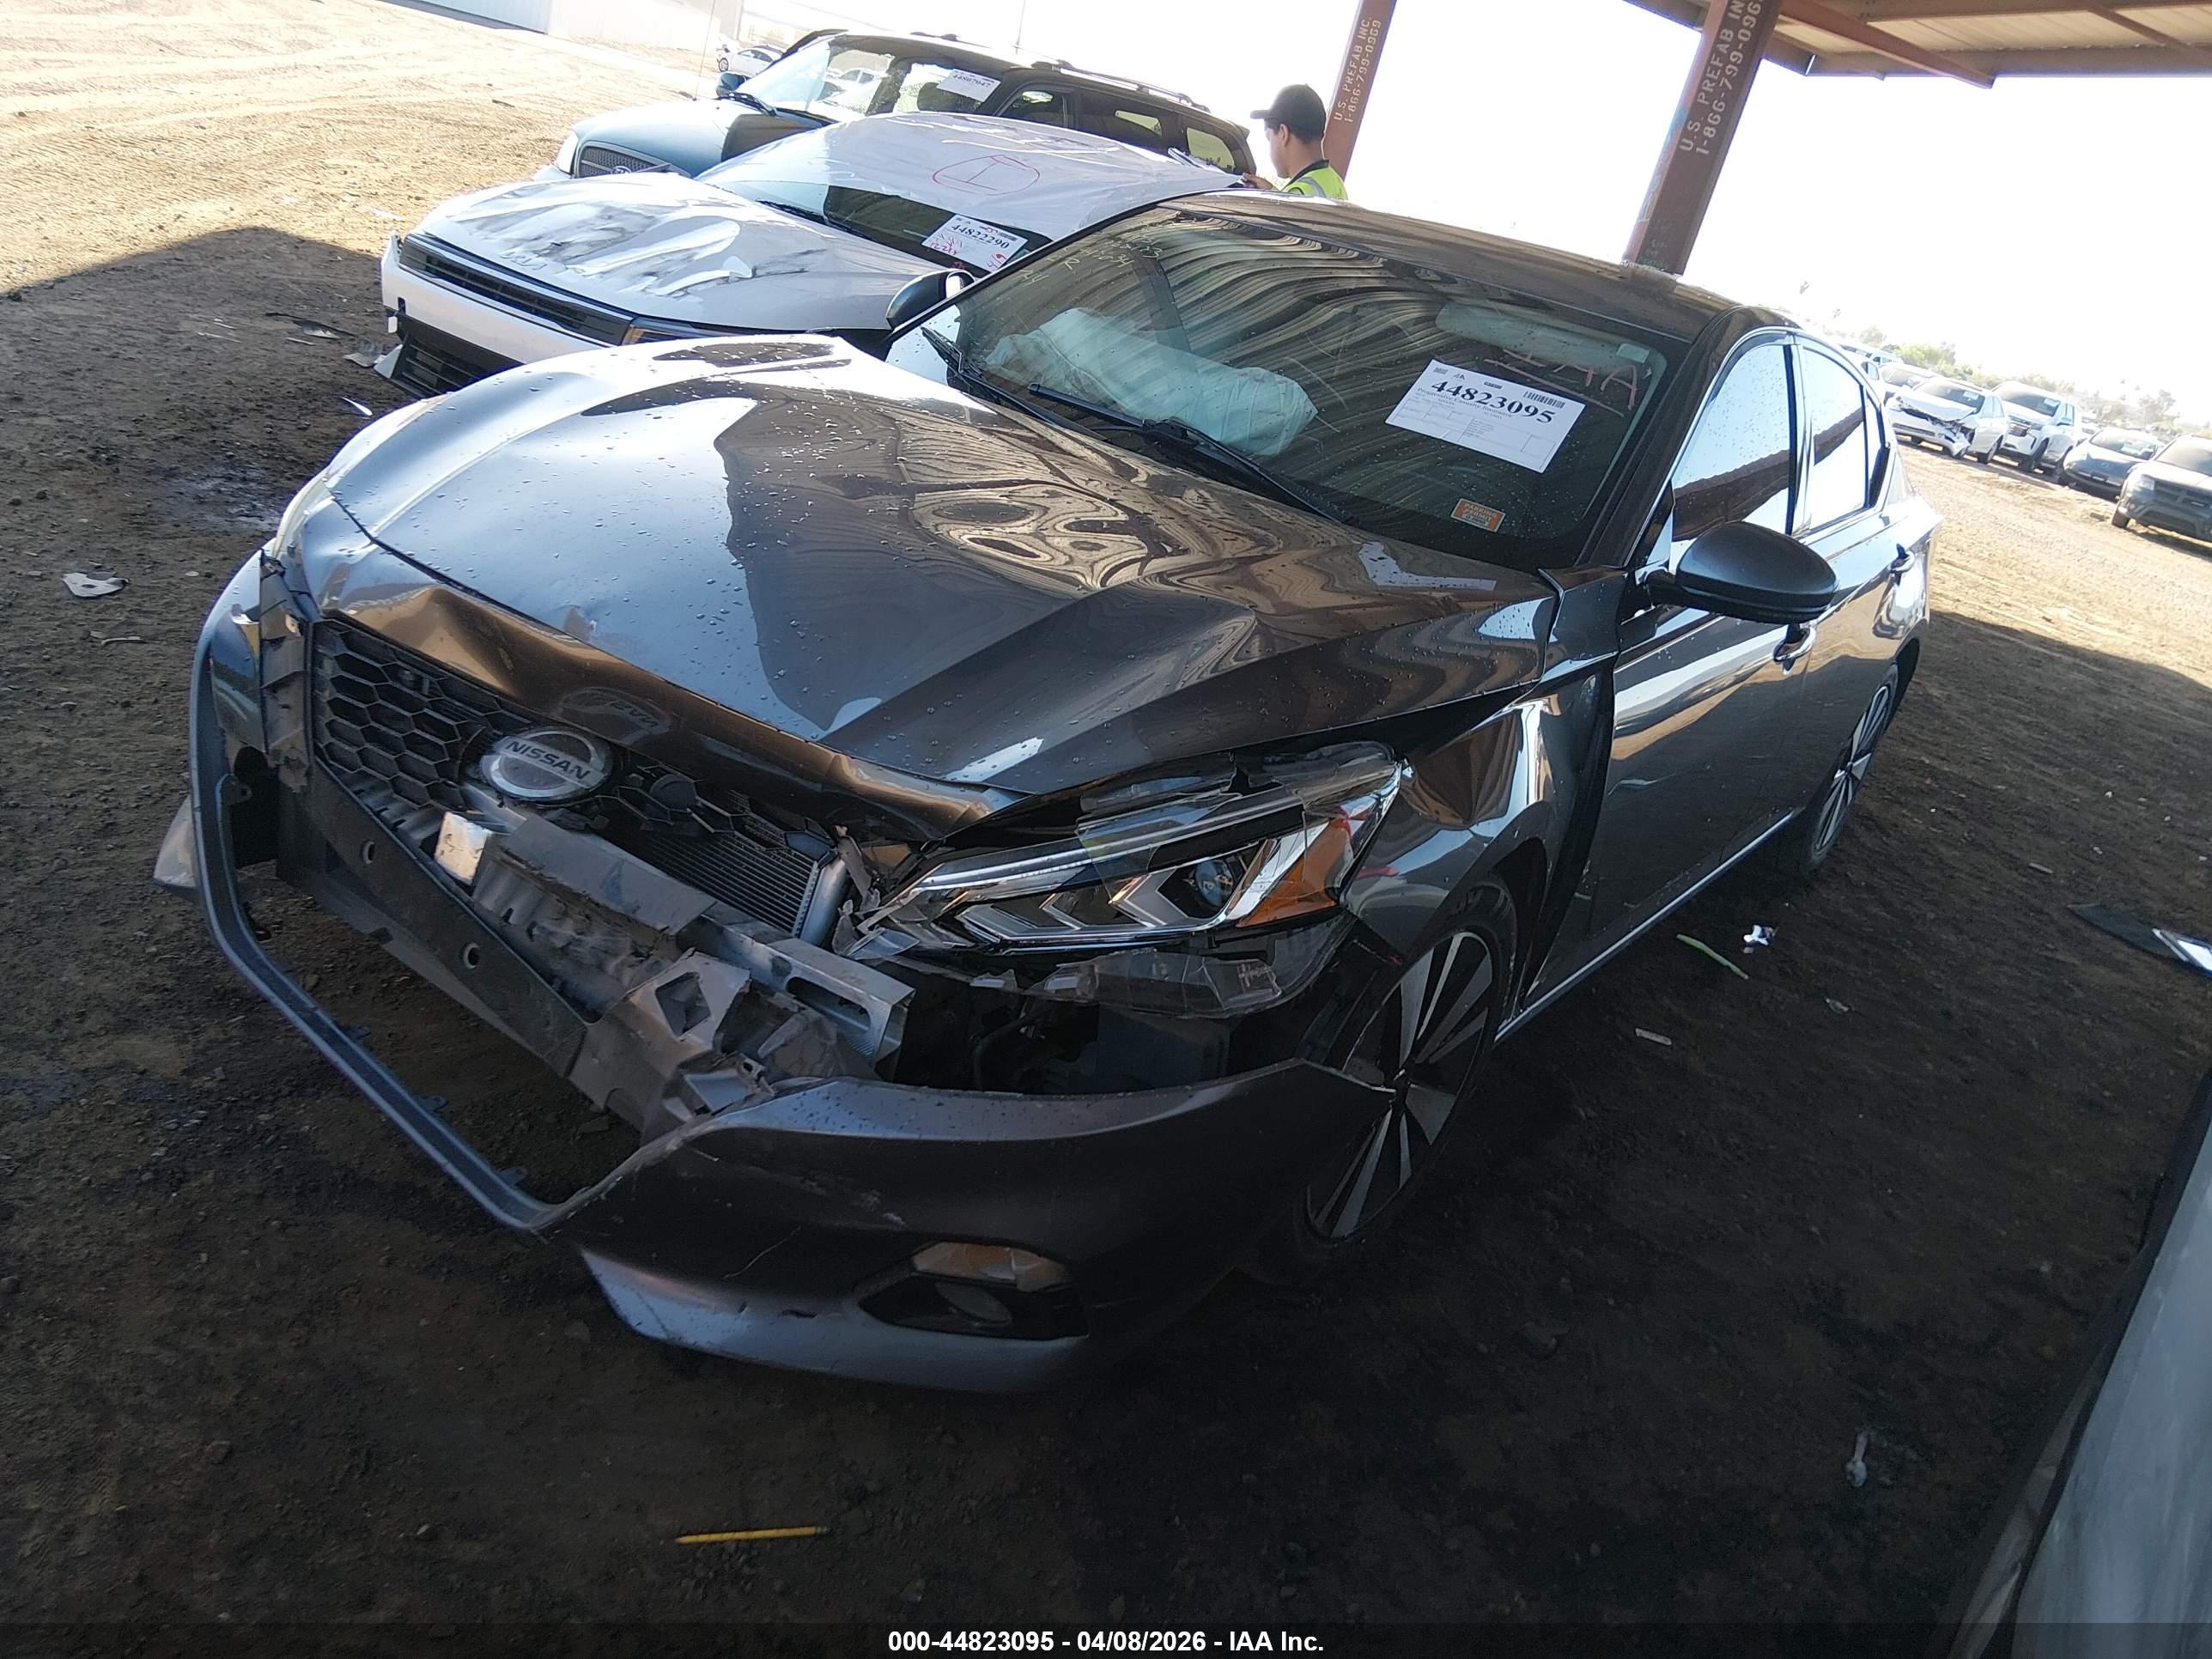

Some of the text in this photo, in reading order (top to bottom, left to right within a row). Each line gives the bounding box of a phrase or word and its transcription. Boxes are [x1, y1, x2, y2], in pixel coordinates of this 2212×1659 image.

[1342, 45, 1363, 92] PREFAB
[1358, 17, 1372, 40] INC.
[1696, 0, 1761, 155] 1-866-799-096
[1697, 28, 1734, 105] PREFAB
[951, 224, 1010, 249] 44822290
[1431, 380, 1557, 423] 44823095
[505, 741, 591, 780] NISSAN
